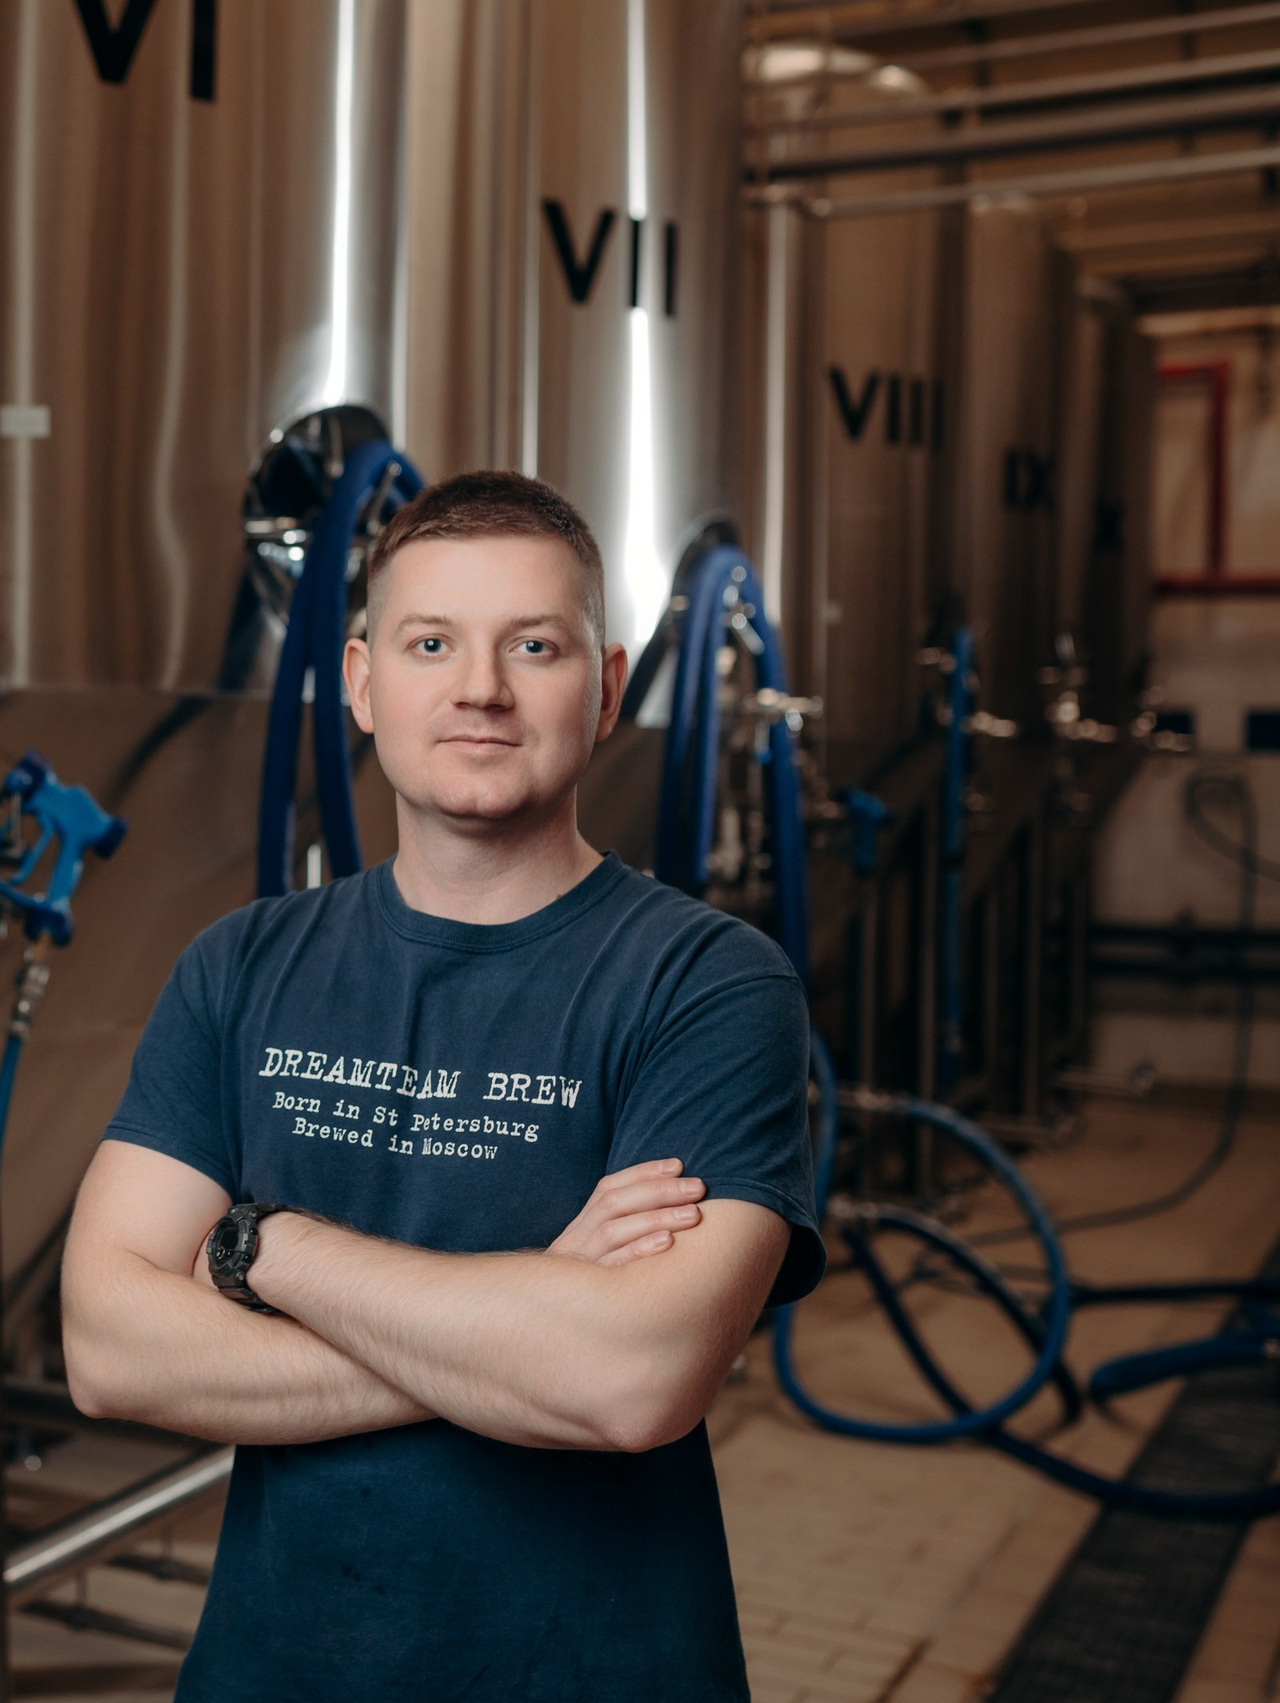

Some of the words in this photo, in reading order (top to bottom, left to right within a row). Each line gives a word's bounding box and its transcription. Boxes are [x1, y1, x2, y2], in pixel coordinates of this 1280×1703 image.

[73, 0, 217, 102] VI
[541, 198, 677, 318] VII
[828, 366, 946, 452] VIII
[258, 1047, 462, 1100] DREAMTEAM
[482, 1071, 583, 1109] BREW
[271, 1091, 321, 1113] Born
[332, 1098, 360, 1120] in
[372, 1105, 399, 1127] St
[409, 1112, 540, 1143] Petersburg
[291, 1116, 374, 1148] Brewed
[387, 1134, 414, 1155] in
[421, 1137, 499, 1160] Moscow
